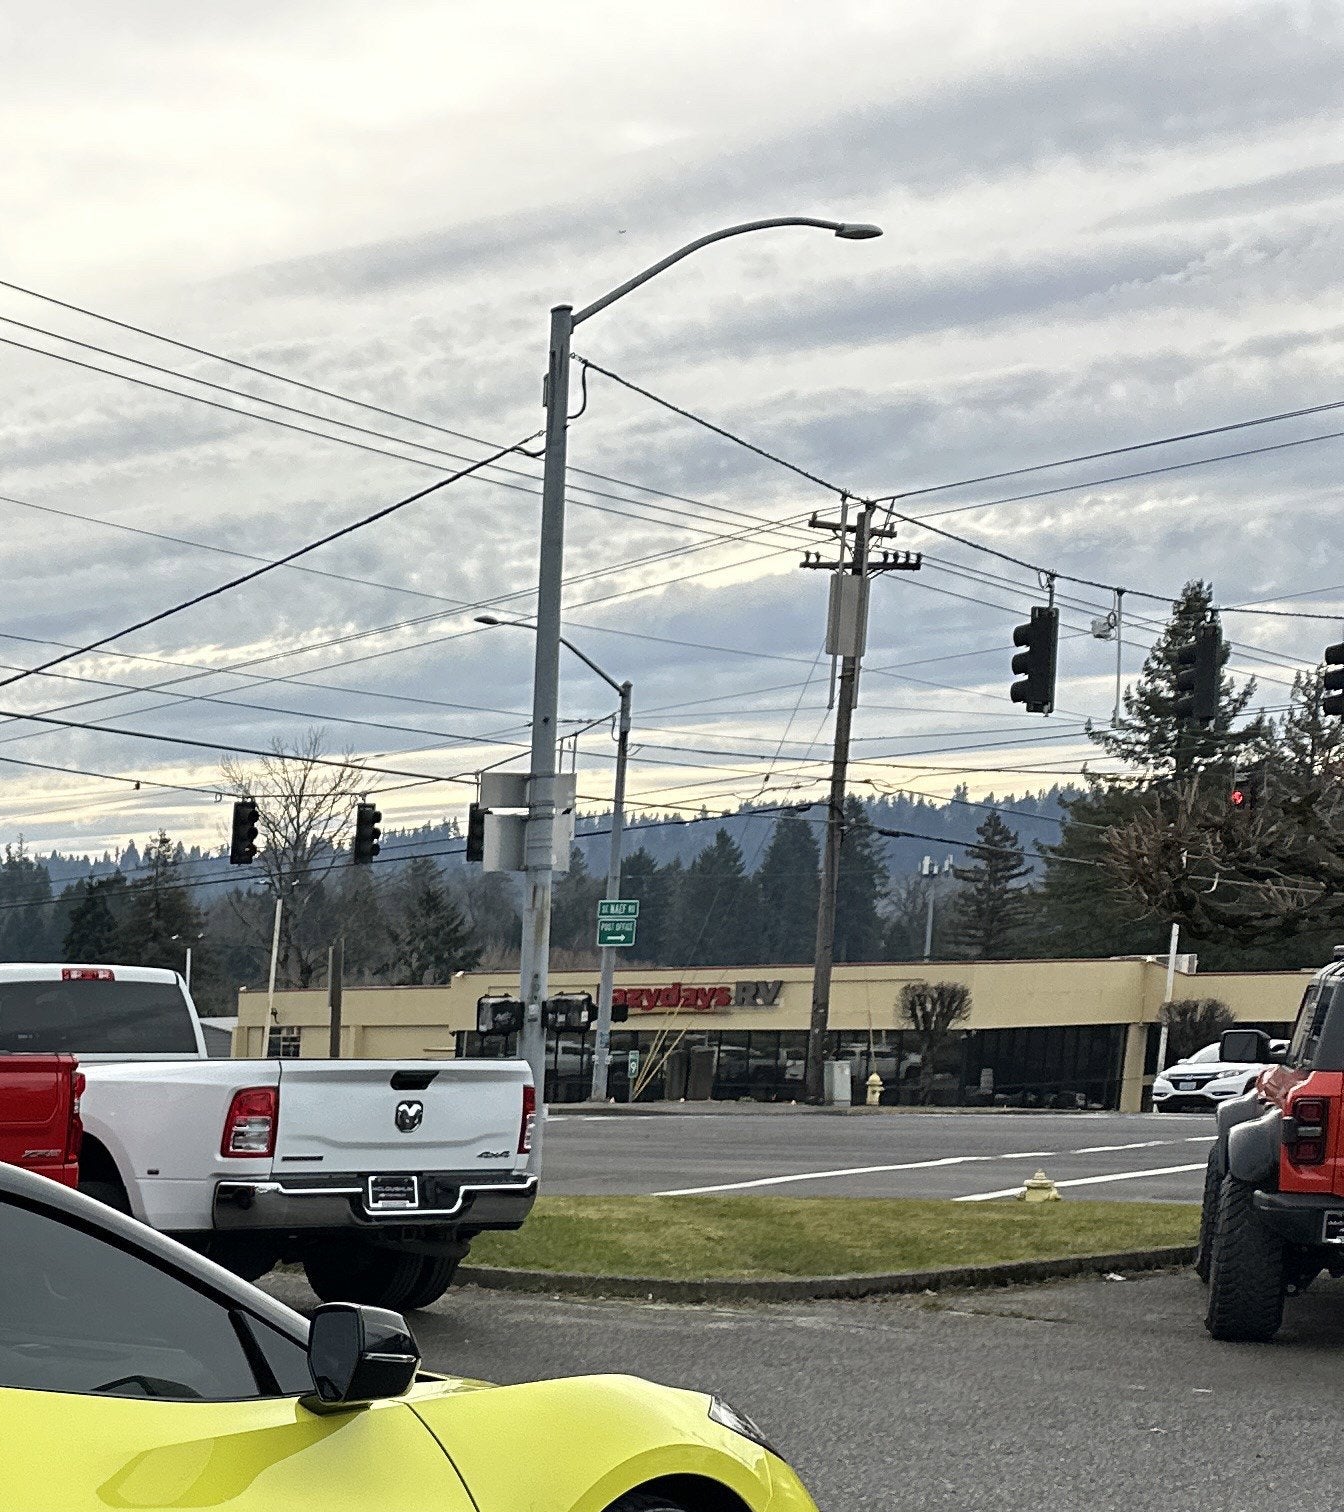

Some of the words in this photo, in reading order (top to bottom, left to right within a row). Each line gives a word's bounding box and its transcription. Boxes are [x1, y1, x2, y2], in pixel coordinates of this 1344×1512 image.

[615, 922, 633, 931] OFFICE
[596, 982, 732, 1010] azydays
[735, 980, 784, 1006] RV
